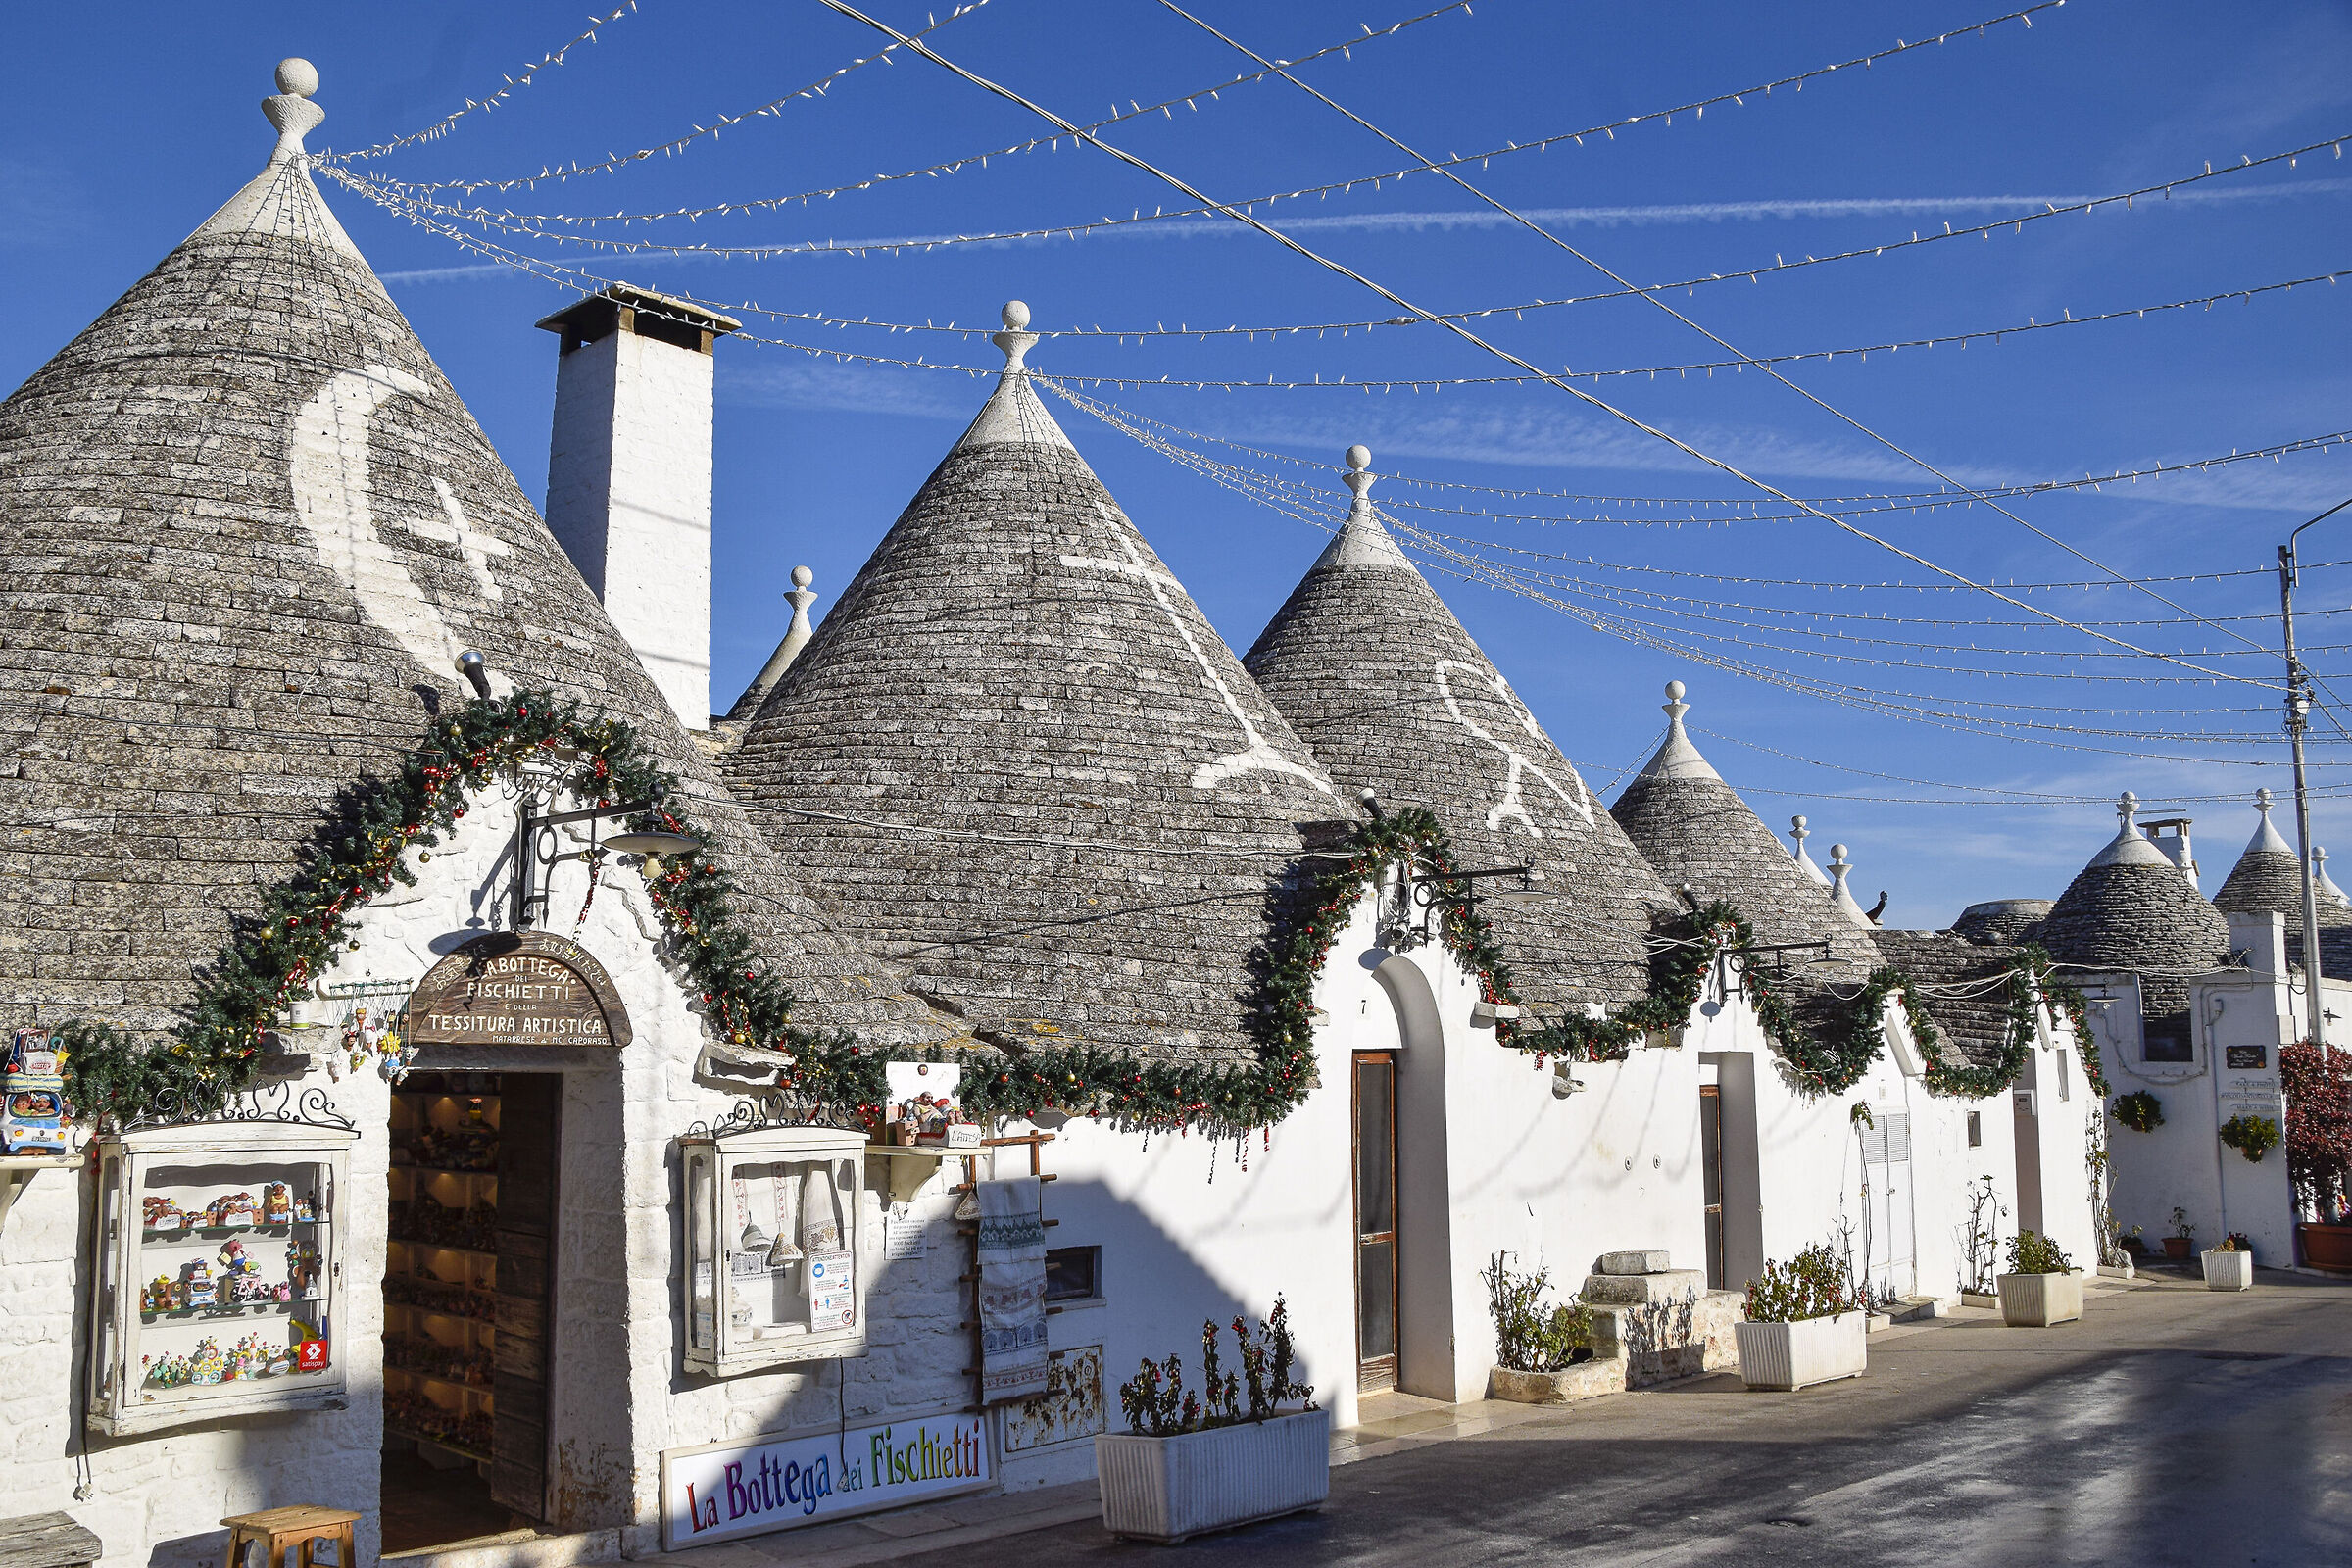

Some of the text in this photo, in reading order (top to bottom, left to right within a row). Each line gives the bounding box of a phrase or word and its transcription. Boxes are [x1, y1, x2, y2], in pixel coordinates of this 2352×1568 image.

[498, 957, 570, 985] BOTTEGA
[514, 974, 529, 983] DEI
[466, 982, 569, 1000] FISCHIETTI
[1360, 999, 1367, 1015] 7
[429, 1014, 602, 1035] TESSITURA ARTISTICA
[492, 1035, 535, 1044] MATARRESE
[686, 1418, 980, 1534] La Bottega dei Fischietti
